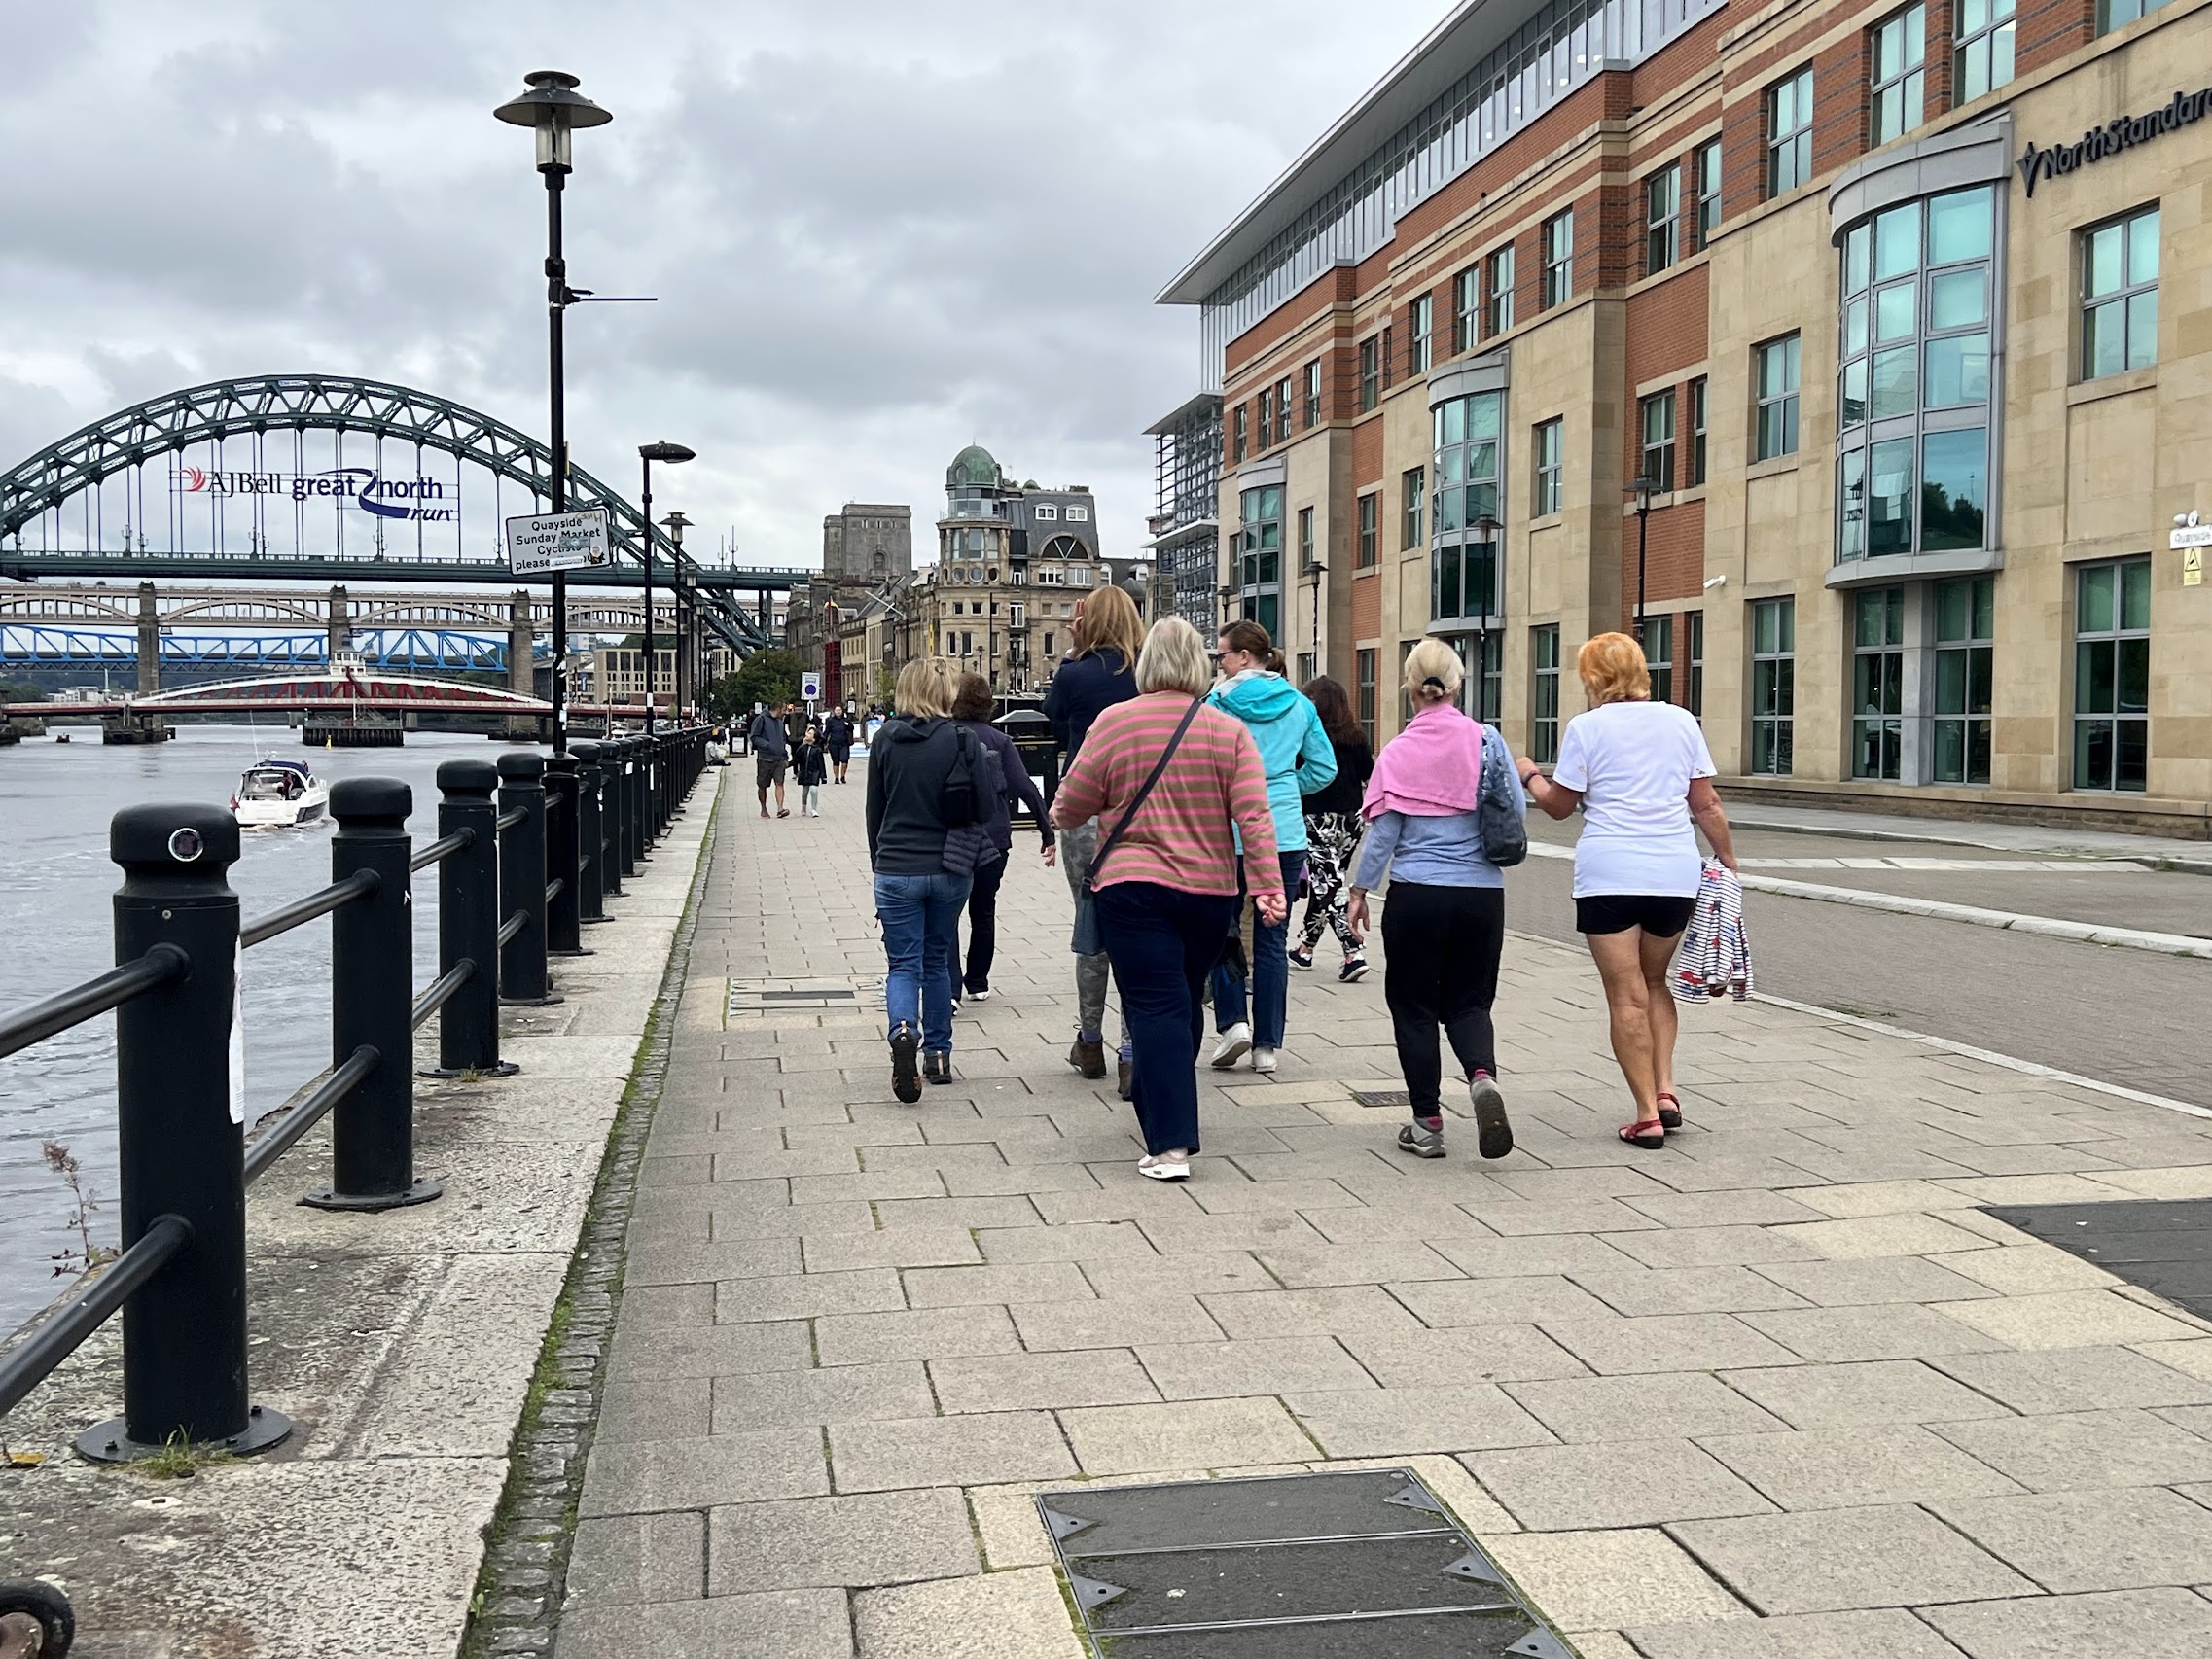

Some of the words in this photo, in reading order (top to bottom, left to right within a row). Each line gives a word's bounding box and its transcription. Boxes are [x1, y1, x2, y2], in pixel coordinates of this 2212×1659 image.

[292, 475, 356, 501] great
[379, 477, 443, 499] north
[410, 506, 450, 522] run
[531, 518, 583, 532] Quayside
[516, 533, 557, 546] Sunday
[560, 527, 601, 539] Market
[2174, 531, 2211, 544] Quayside
[516, 558, 551, 572] please
